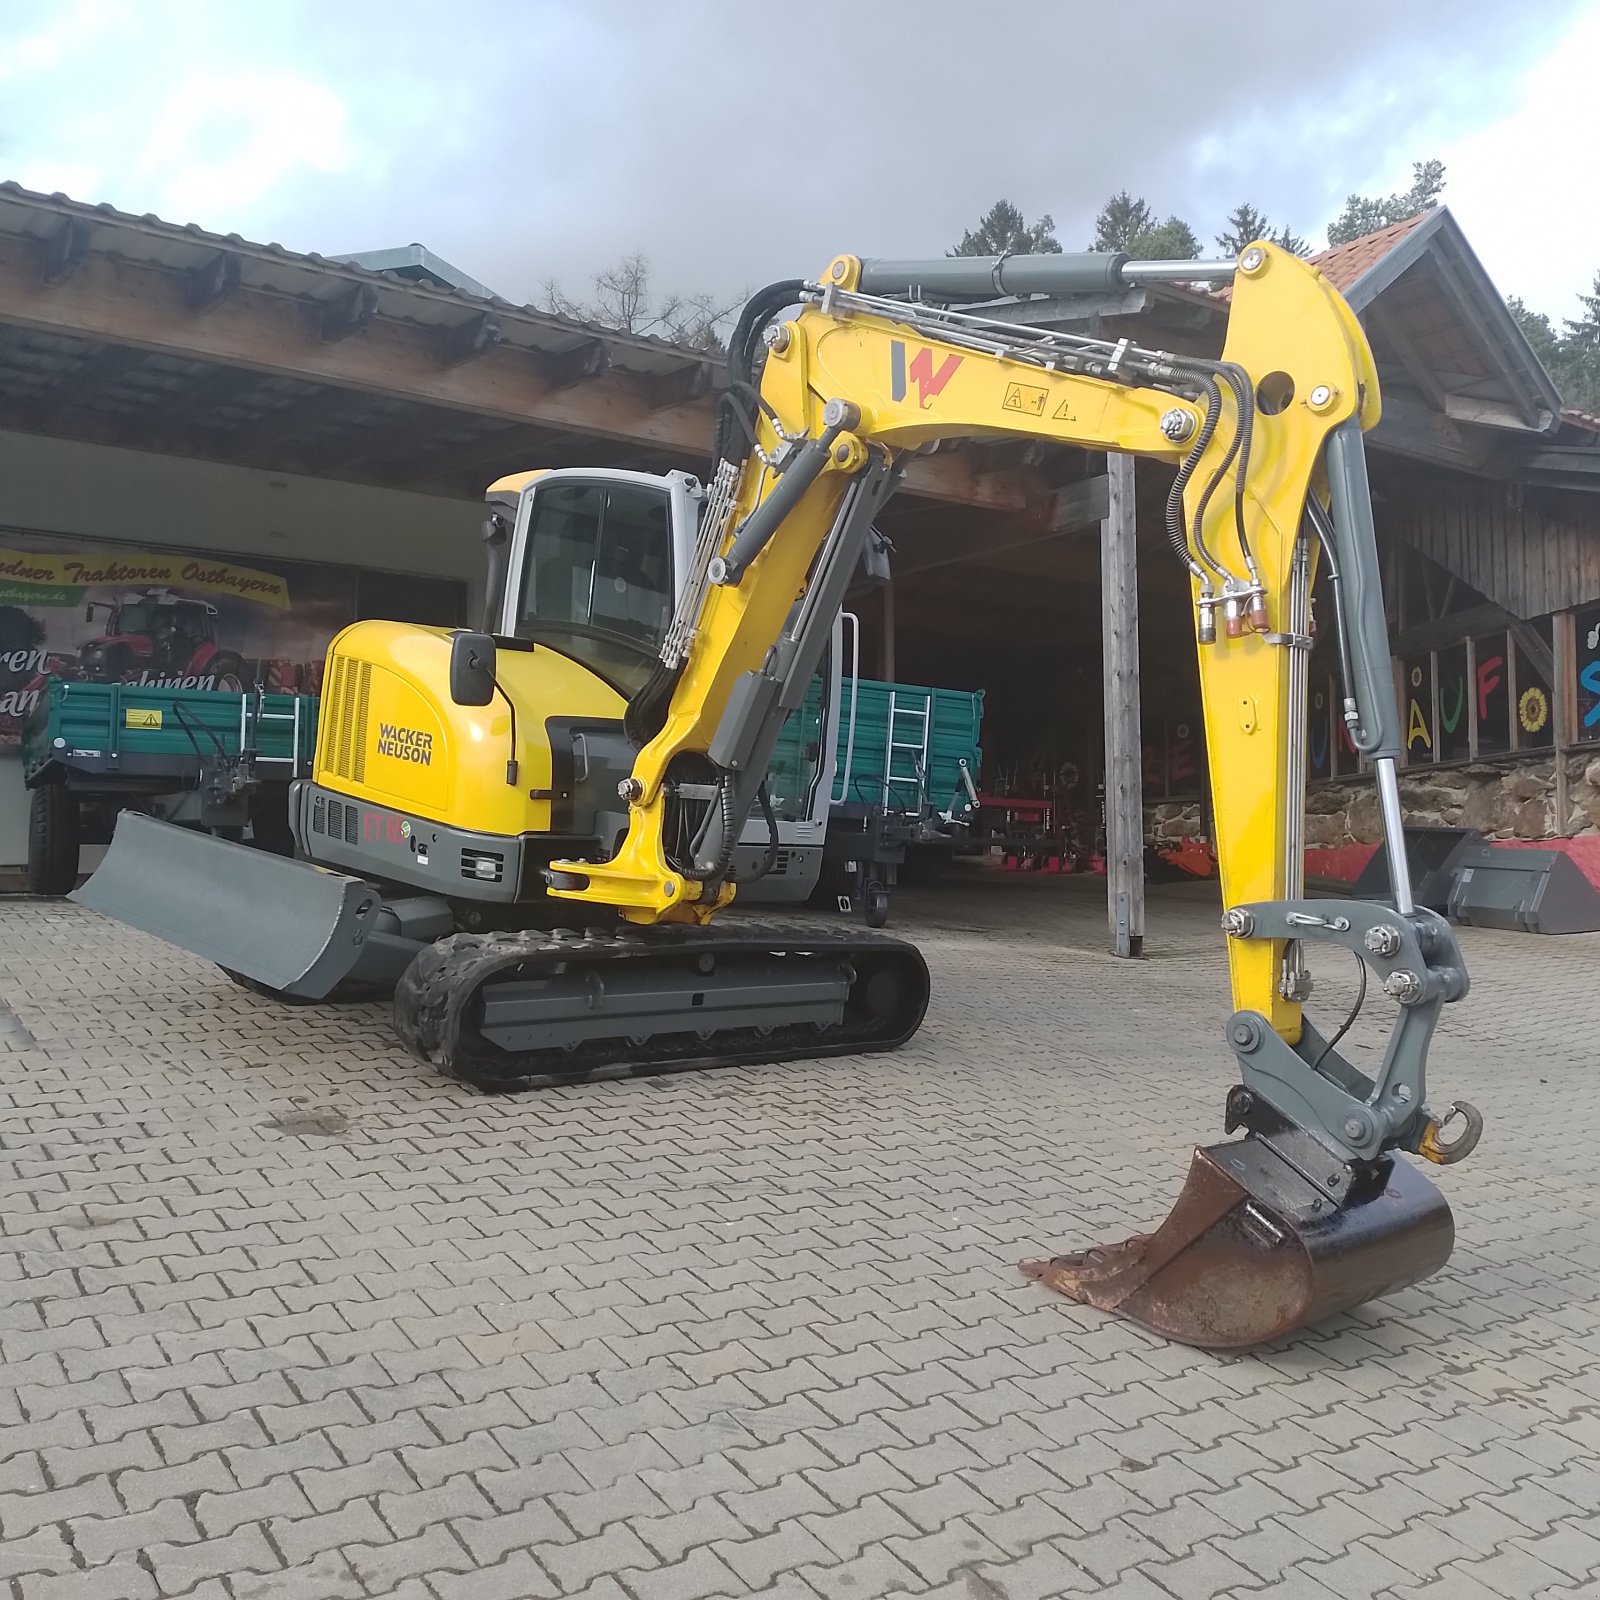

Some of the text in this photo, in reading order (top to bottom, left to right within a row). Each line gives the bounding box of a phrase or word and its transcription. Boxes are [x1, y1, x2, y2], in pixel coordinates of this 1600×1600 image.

[64, 562, 172, 583] Traktoren
[181, 562, 281, 594] Ostbayern
[379, 723, 433, 750] WACKER
[377, 739, 432, 766] NEUSON
[364, 812, 385, 841] ET
